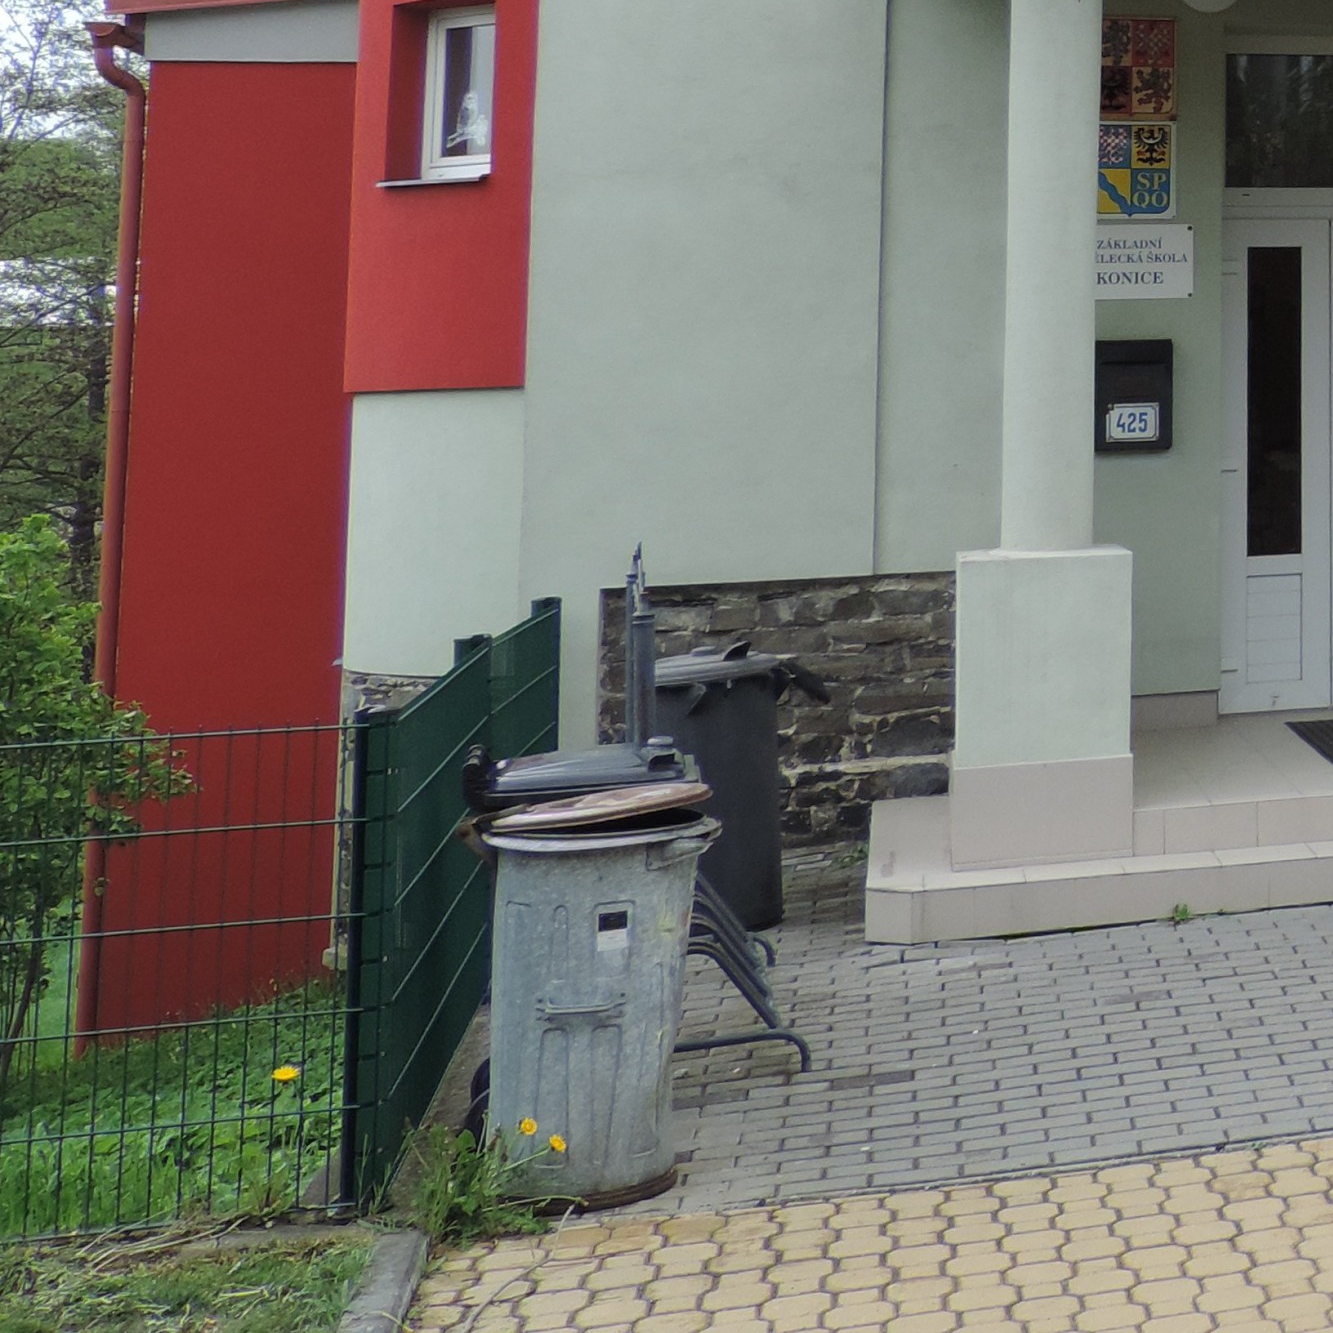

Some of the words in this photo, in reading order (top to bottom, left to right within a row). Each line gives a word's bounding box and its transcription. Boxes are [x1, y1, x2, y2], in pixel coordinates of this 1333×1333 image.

[1096, 237, 1162, 249] ZÁKLADNÍ
[1146, 251, 1188, 263] ŠKOLA
[1096, 271, 1164, 285] KONICE
[1116, 412, 1148, 433] 425
